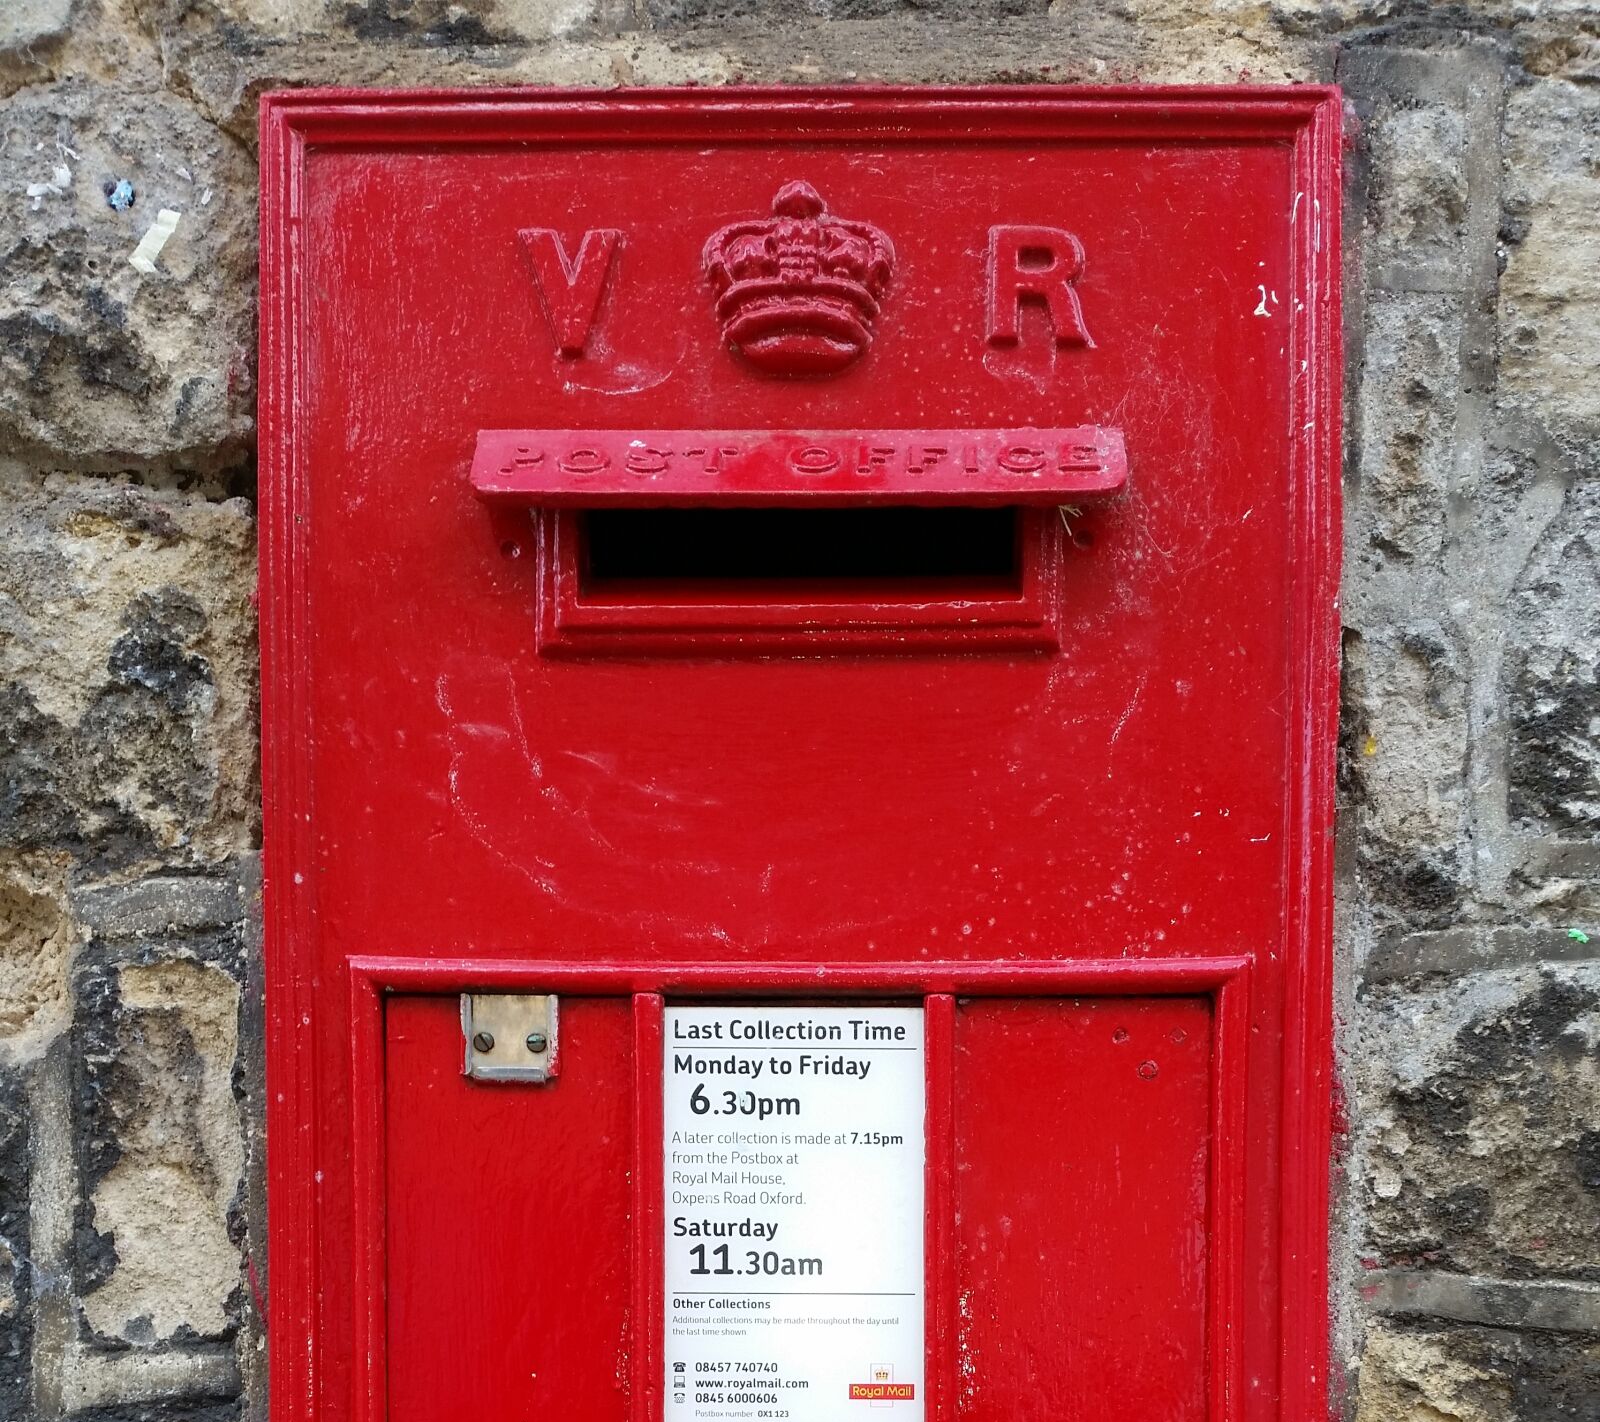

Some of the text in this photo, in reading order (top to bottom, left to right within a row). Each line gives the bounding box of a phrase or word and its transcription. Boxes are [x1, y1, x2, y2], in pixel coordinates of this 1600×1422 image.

[517, 224, 1098, 358] V R
[499, 443, 1104, 476] POST OFFICE
[674, 1019, 906, 1041] Last Collection Time
[674, 1054, 871, 1080] Monday to Friday
[690, 1082, 800, 1120] 6.30pm
[672, 1132, 904, 1147] A later collection is made at 7.15pm
[672, 1150, 799, 1165] from the Postbox at
[672, 1171, 786, 1186] Royal Mail House,
[672, 1191, 806, 1206] Oxpens Road Oxford.
[673, 1216, 778, 1242] Saturday
[689, 1243, 823, 1276] 11.30am
[672, 1298, 771, 1310] Other Collections
[672, 1316, 899, 1327] Additional collections may be made throughout the day until
[672, 1328, 747, 1336] the last time shown
[695, 1362, 778, 1373] 08457 740740
[695, 1377, 809, 1390] www.royalmail.com
[852, 1385, 912, 1396] Royal Mail
[695, 1392, 778, 1404] 0845 6000606
[695, 1410, 723, 1418] Postbox
[726, 1410, 754, 1418] number
[774, 1410, 790, 1418] 123
